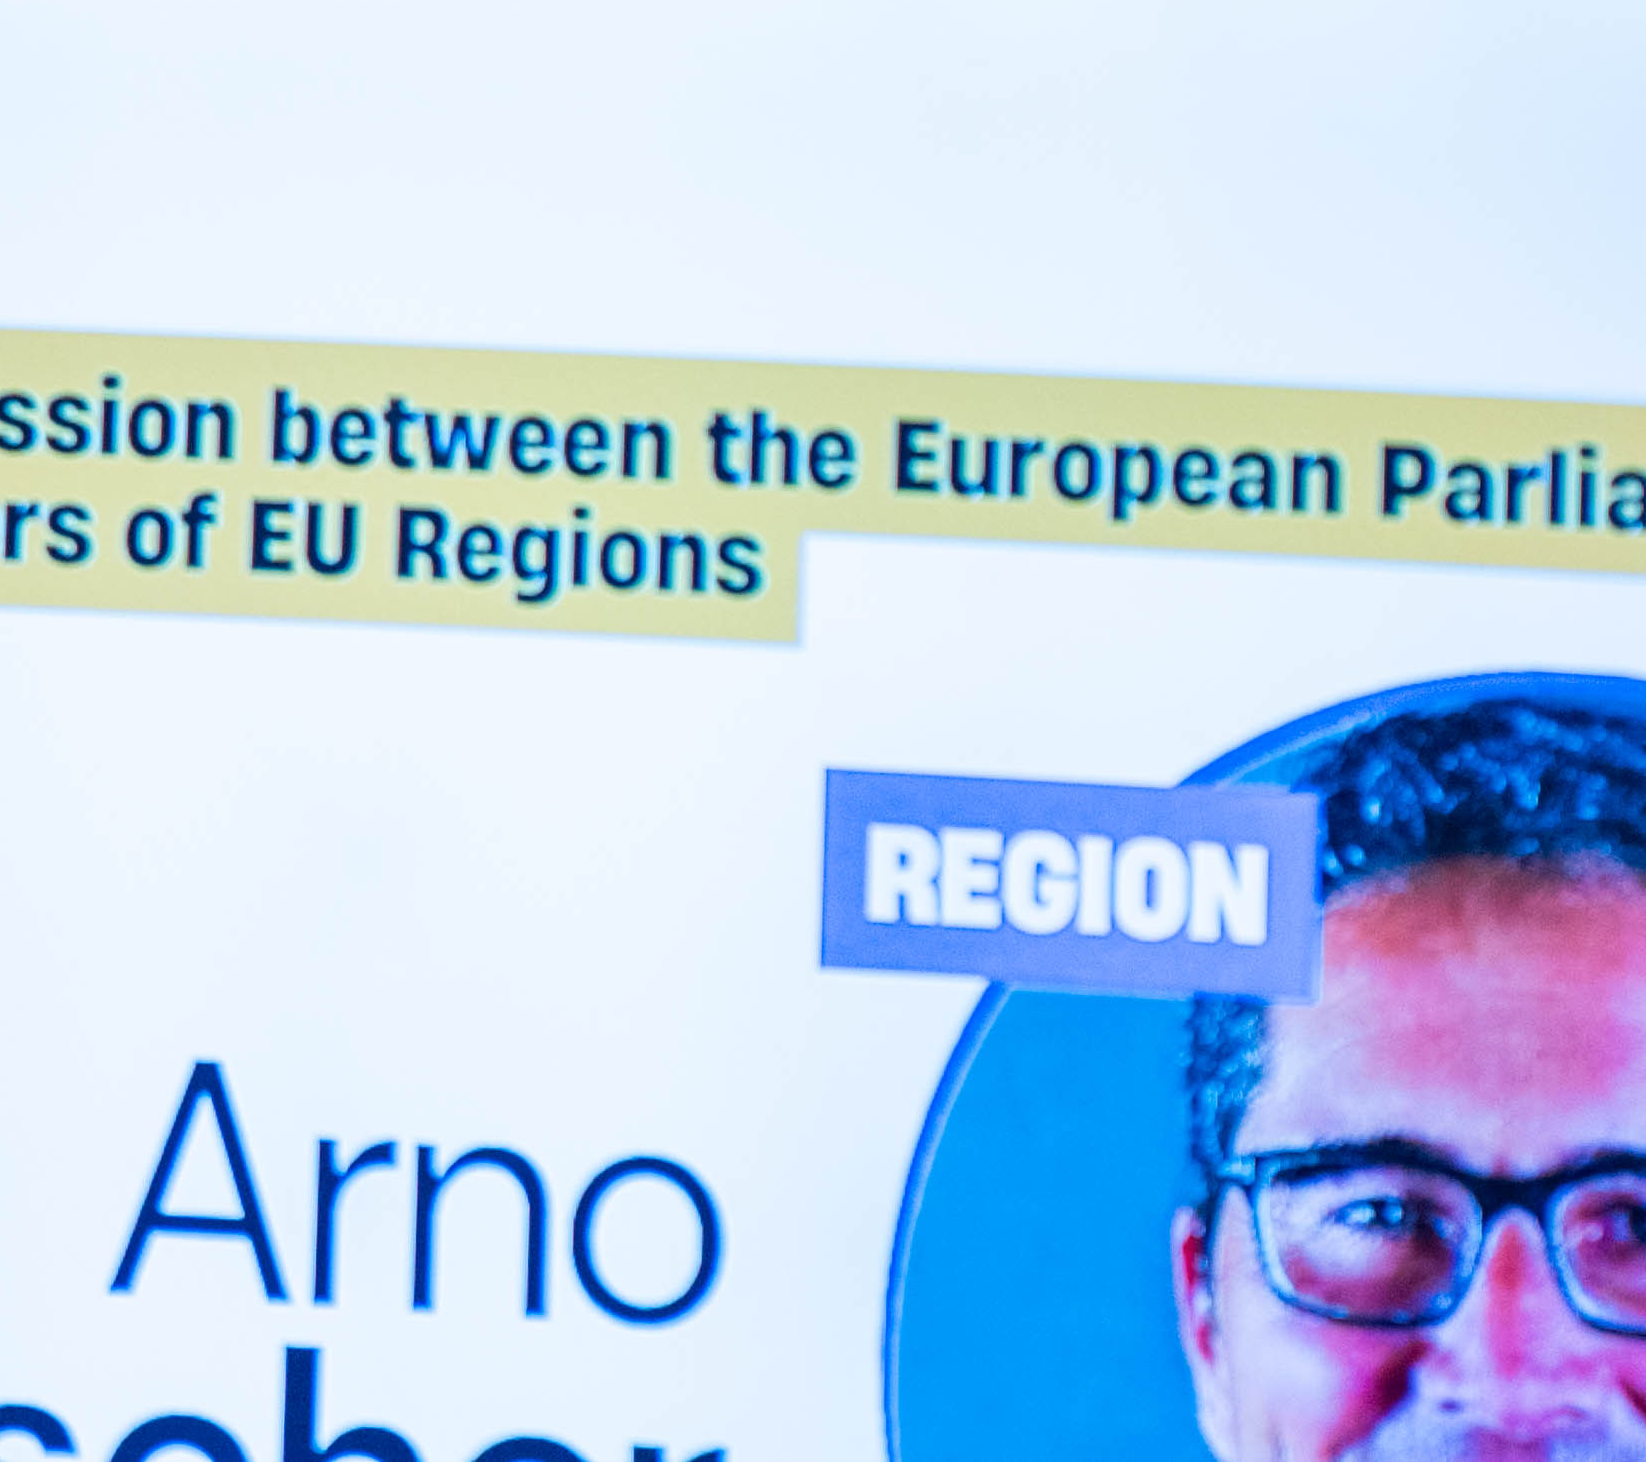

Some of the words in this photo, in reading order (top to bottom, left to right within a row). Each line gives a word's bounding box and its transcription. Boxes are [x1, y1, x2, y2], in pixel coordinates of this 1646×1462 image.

[272, 389, 674, 480] between
[708, 412, 857, 490] the
[895, 420, 1343, 523] European
[125, 495, 217, 572] of
[251, 503, 360, 577] EU
[396, 508, 765, 602] Regions
[866, 824, 1268, 945] REGION
[110, 1061, 722, 1325] Arno
